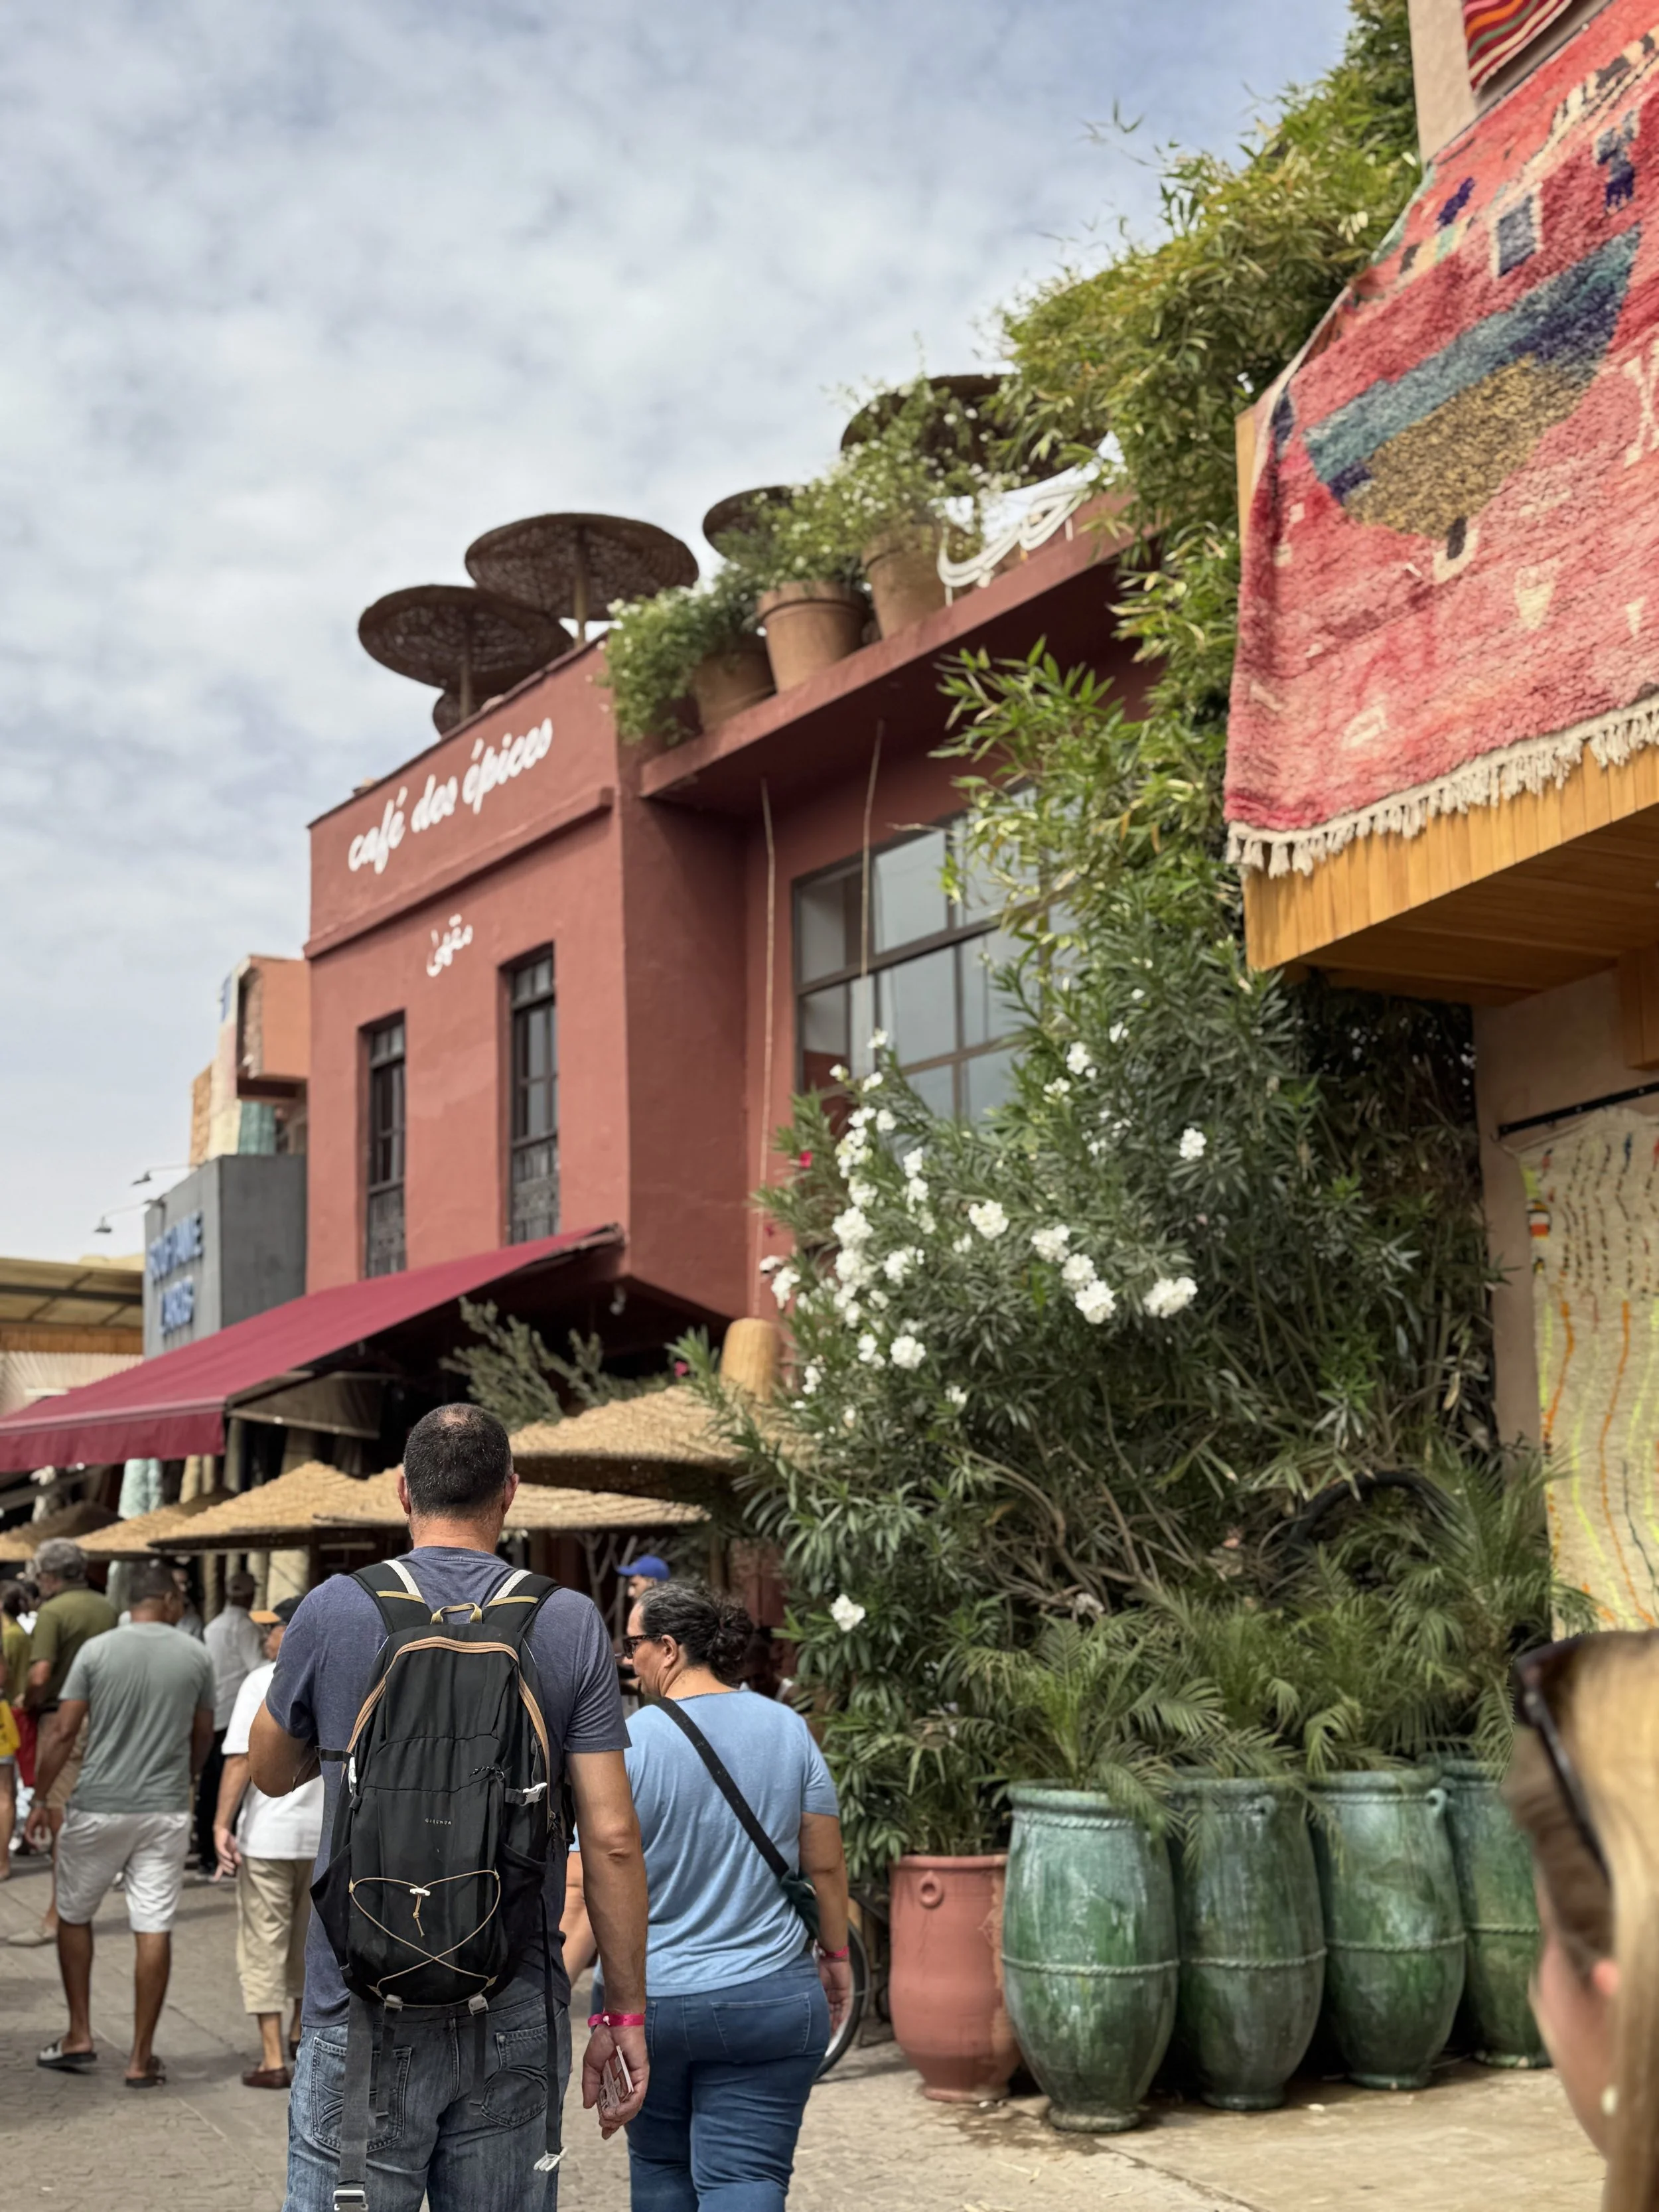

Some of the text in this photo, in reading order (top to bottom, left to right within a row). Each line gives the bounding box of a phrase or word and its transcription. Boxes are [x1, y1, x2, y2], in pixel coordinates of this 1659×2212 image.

[348, 717, 553, 874] café des épices
